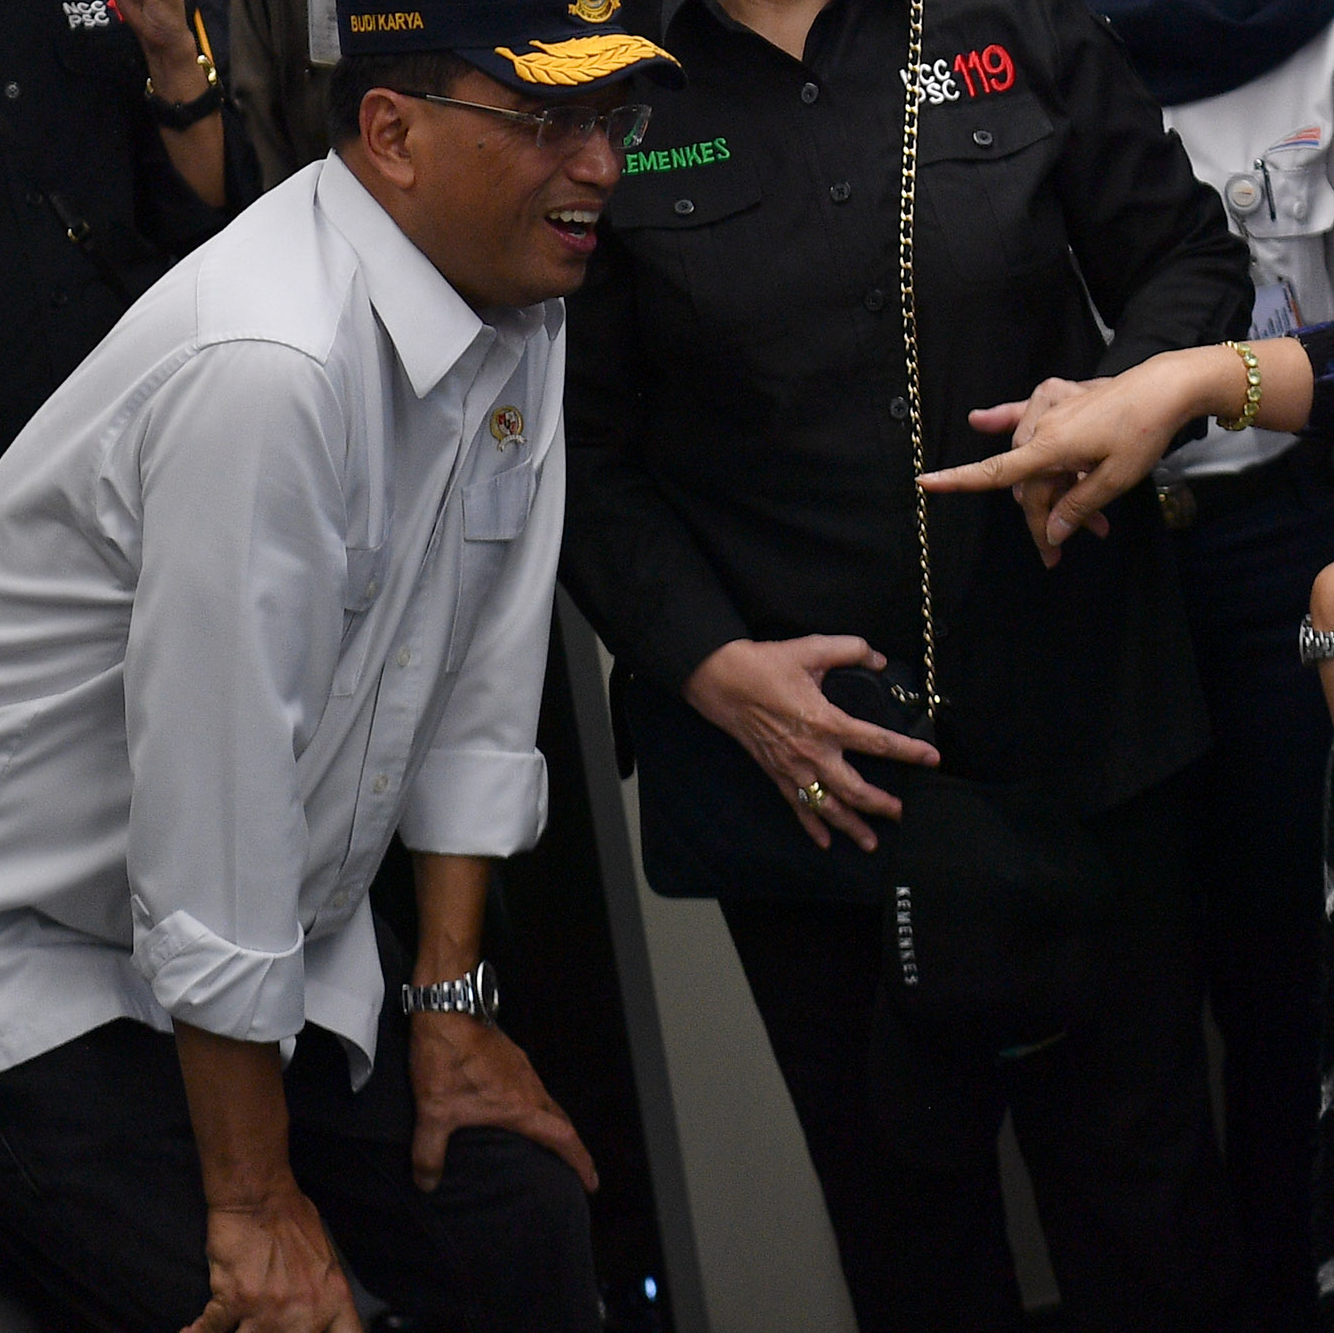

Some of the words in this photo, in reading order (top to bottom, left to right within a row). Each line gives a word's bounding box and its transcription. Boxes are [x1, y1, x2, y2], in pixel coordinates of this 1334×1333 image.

[62, 0, 107, 17] NCC
[68, 11, 111, 31] PSC
[350, 13, 376, 33] BUDI
[377, 11, 425, 31] KARYA
[953, 44, 1016, 98] 119
[622, 137, 731, 175] EMENKES
